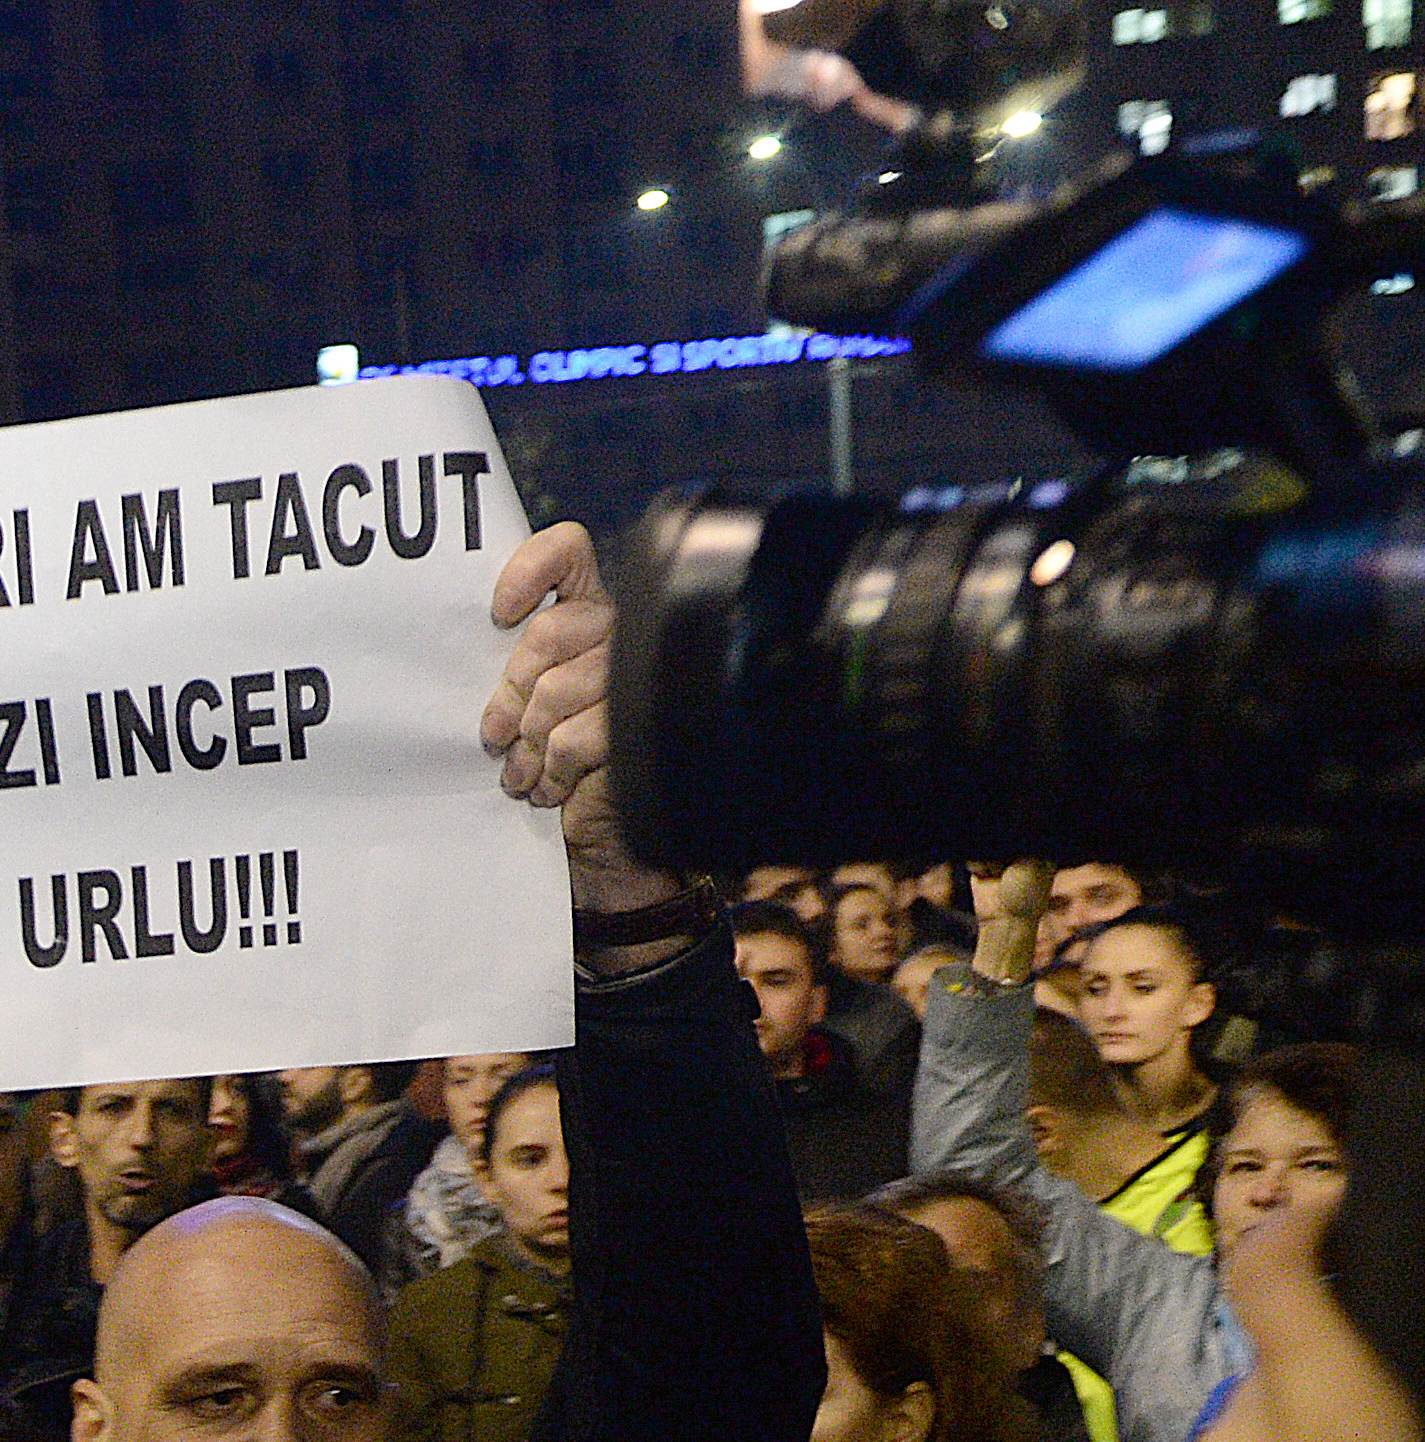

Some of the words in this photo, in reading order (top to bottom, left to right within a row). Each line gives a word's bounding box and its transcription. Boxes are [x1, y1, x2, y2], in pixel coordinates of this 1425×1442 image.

[67, 488, 185, 600] AM
[212, 451, 491, 580] TACUT
[87, 667, 331, 780] INCEP
[18, 849, 301, 969] URLU!!!
